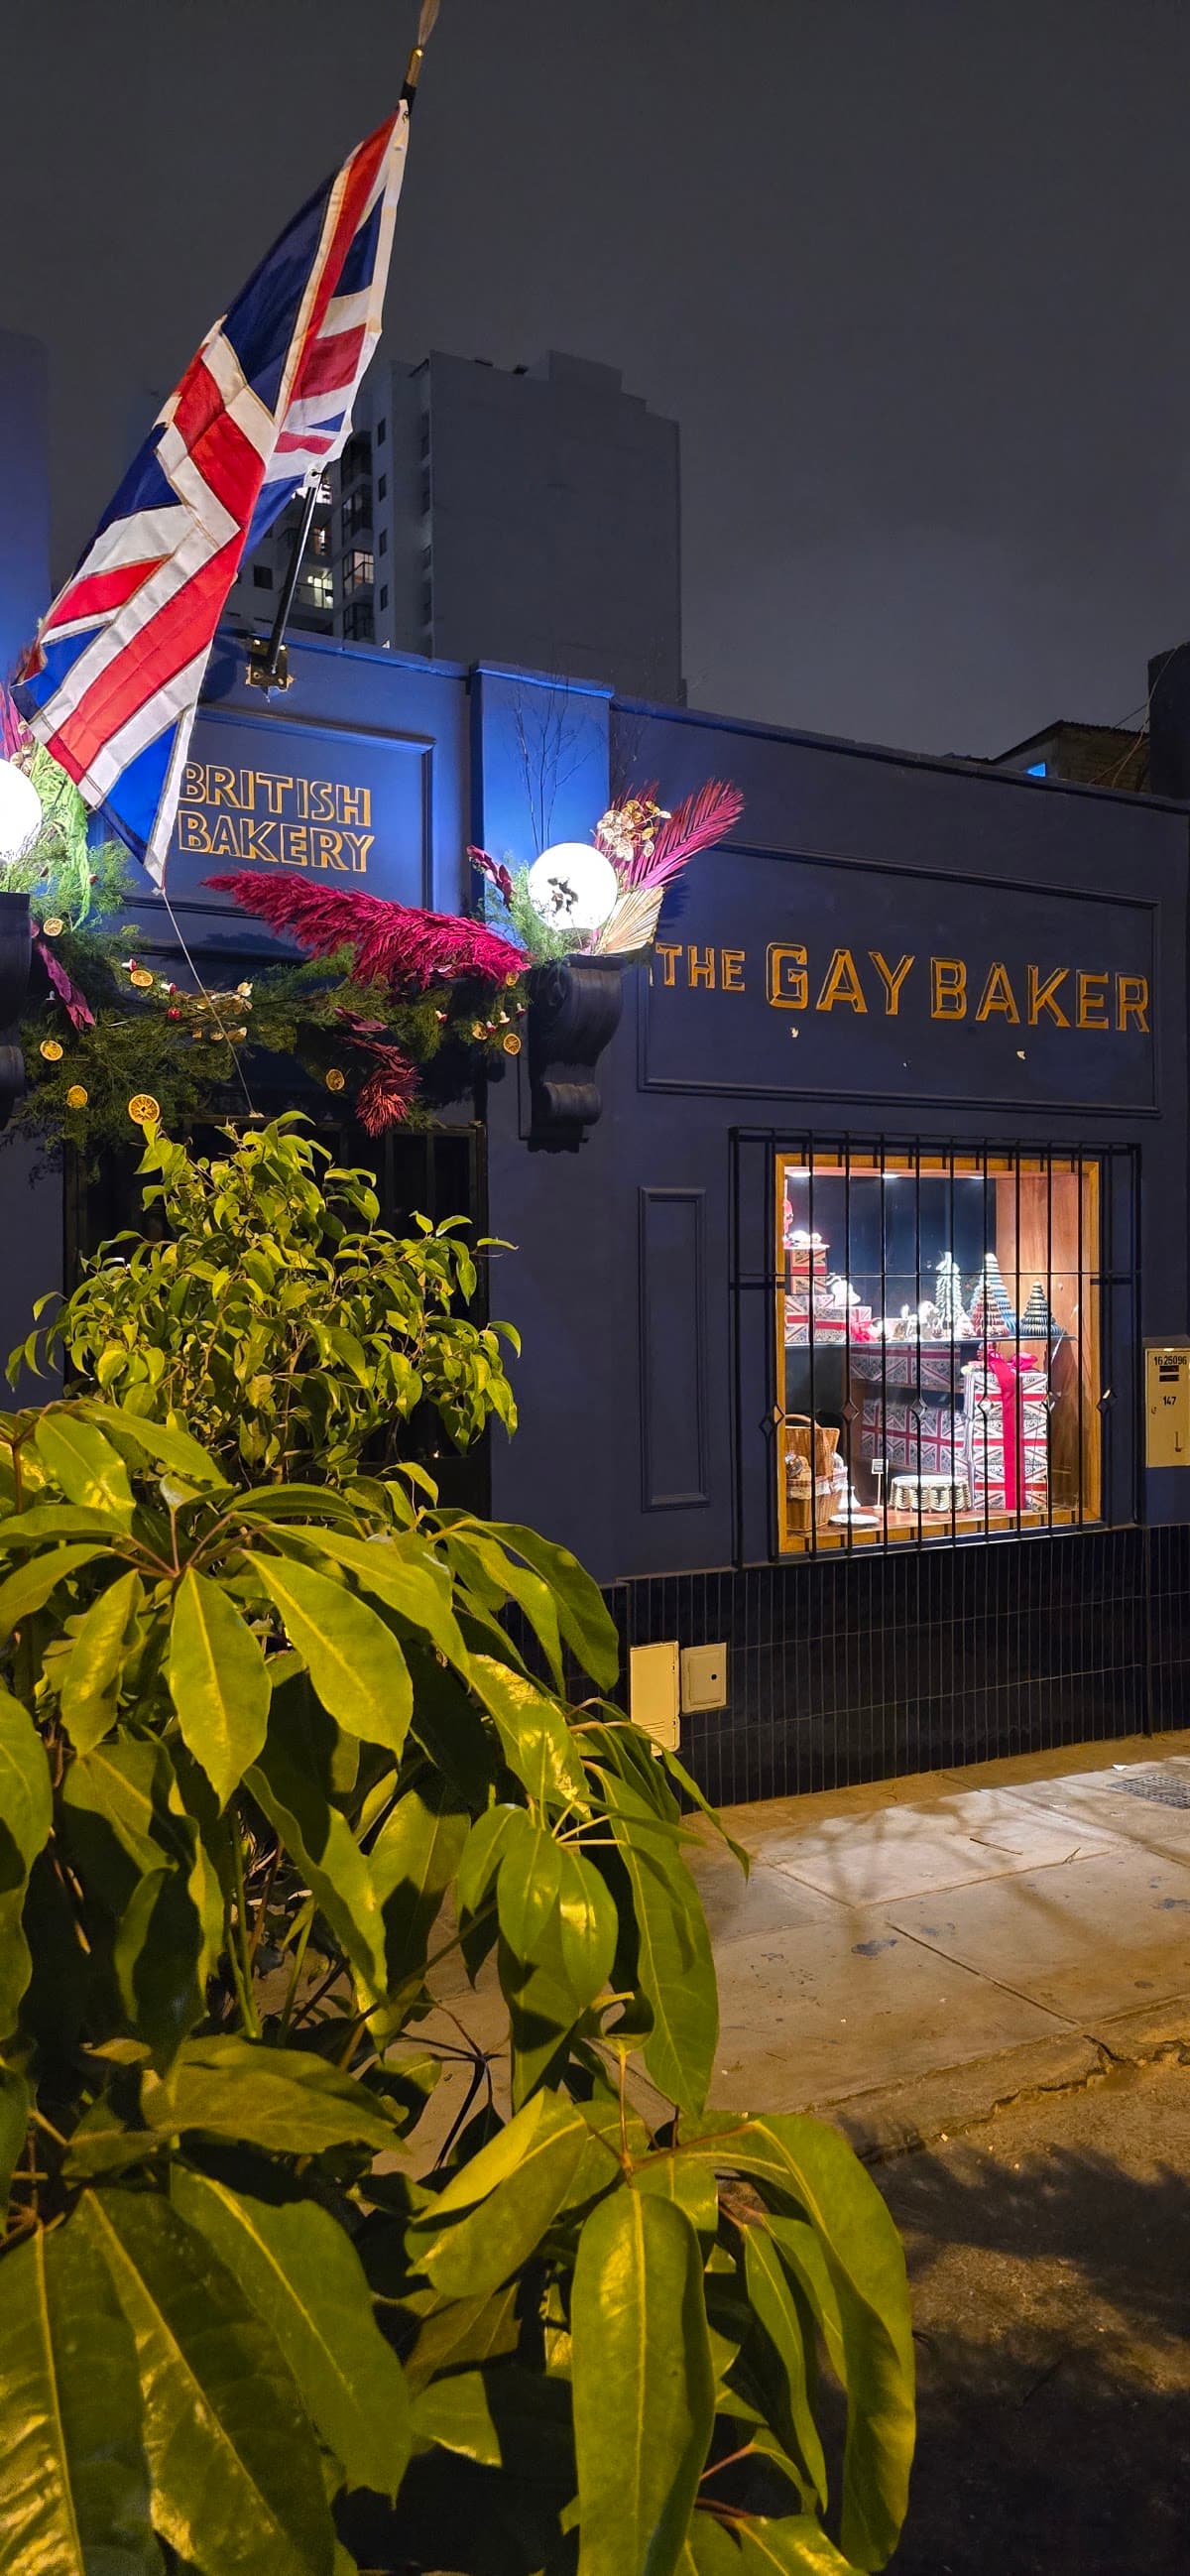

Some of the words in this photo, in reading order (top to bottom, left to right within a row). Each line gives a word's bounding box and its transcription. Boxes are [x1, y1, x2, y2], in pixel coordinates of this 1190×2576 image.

[179, 761, 371, 827] BRITISH
[178, 809, 375, 873] BAKERY
[654, 941, 746, 992] THE
[766, 941, 916, 1016] GAY
[930, 956, 1150, 1033] BAKER
[1163, 1396, 1177, 1406] 147
